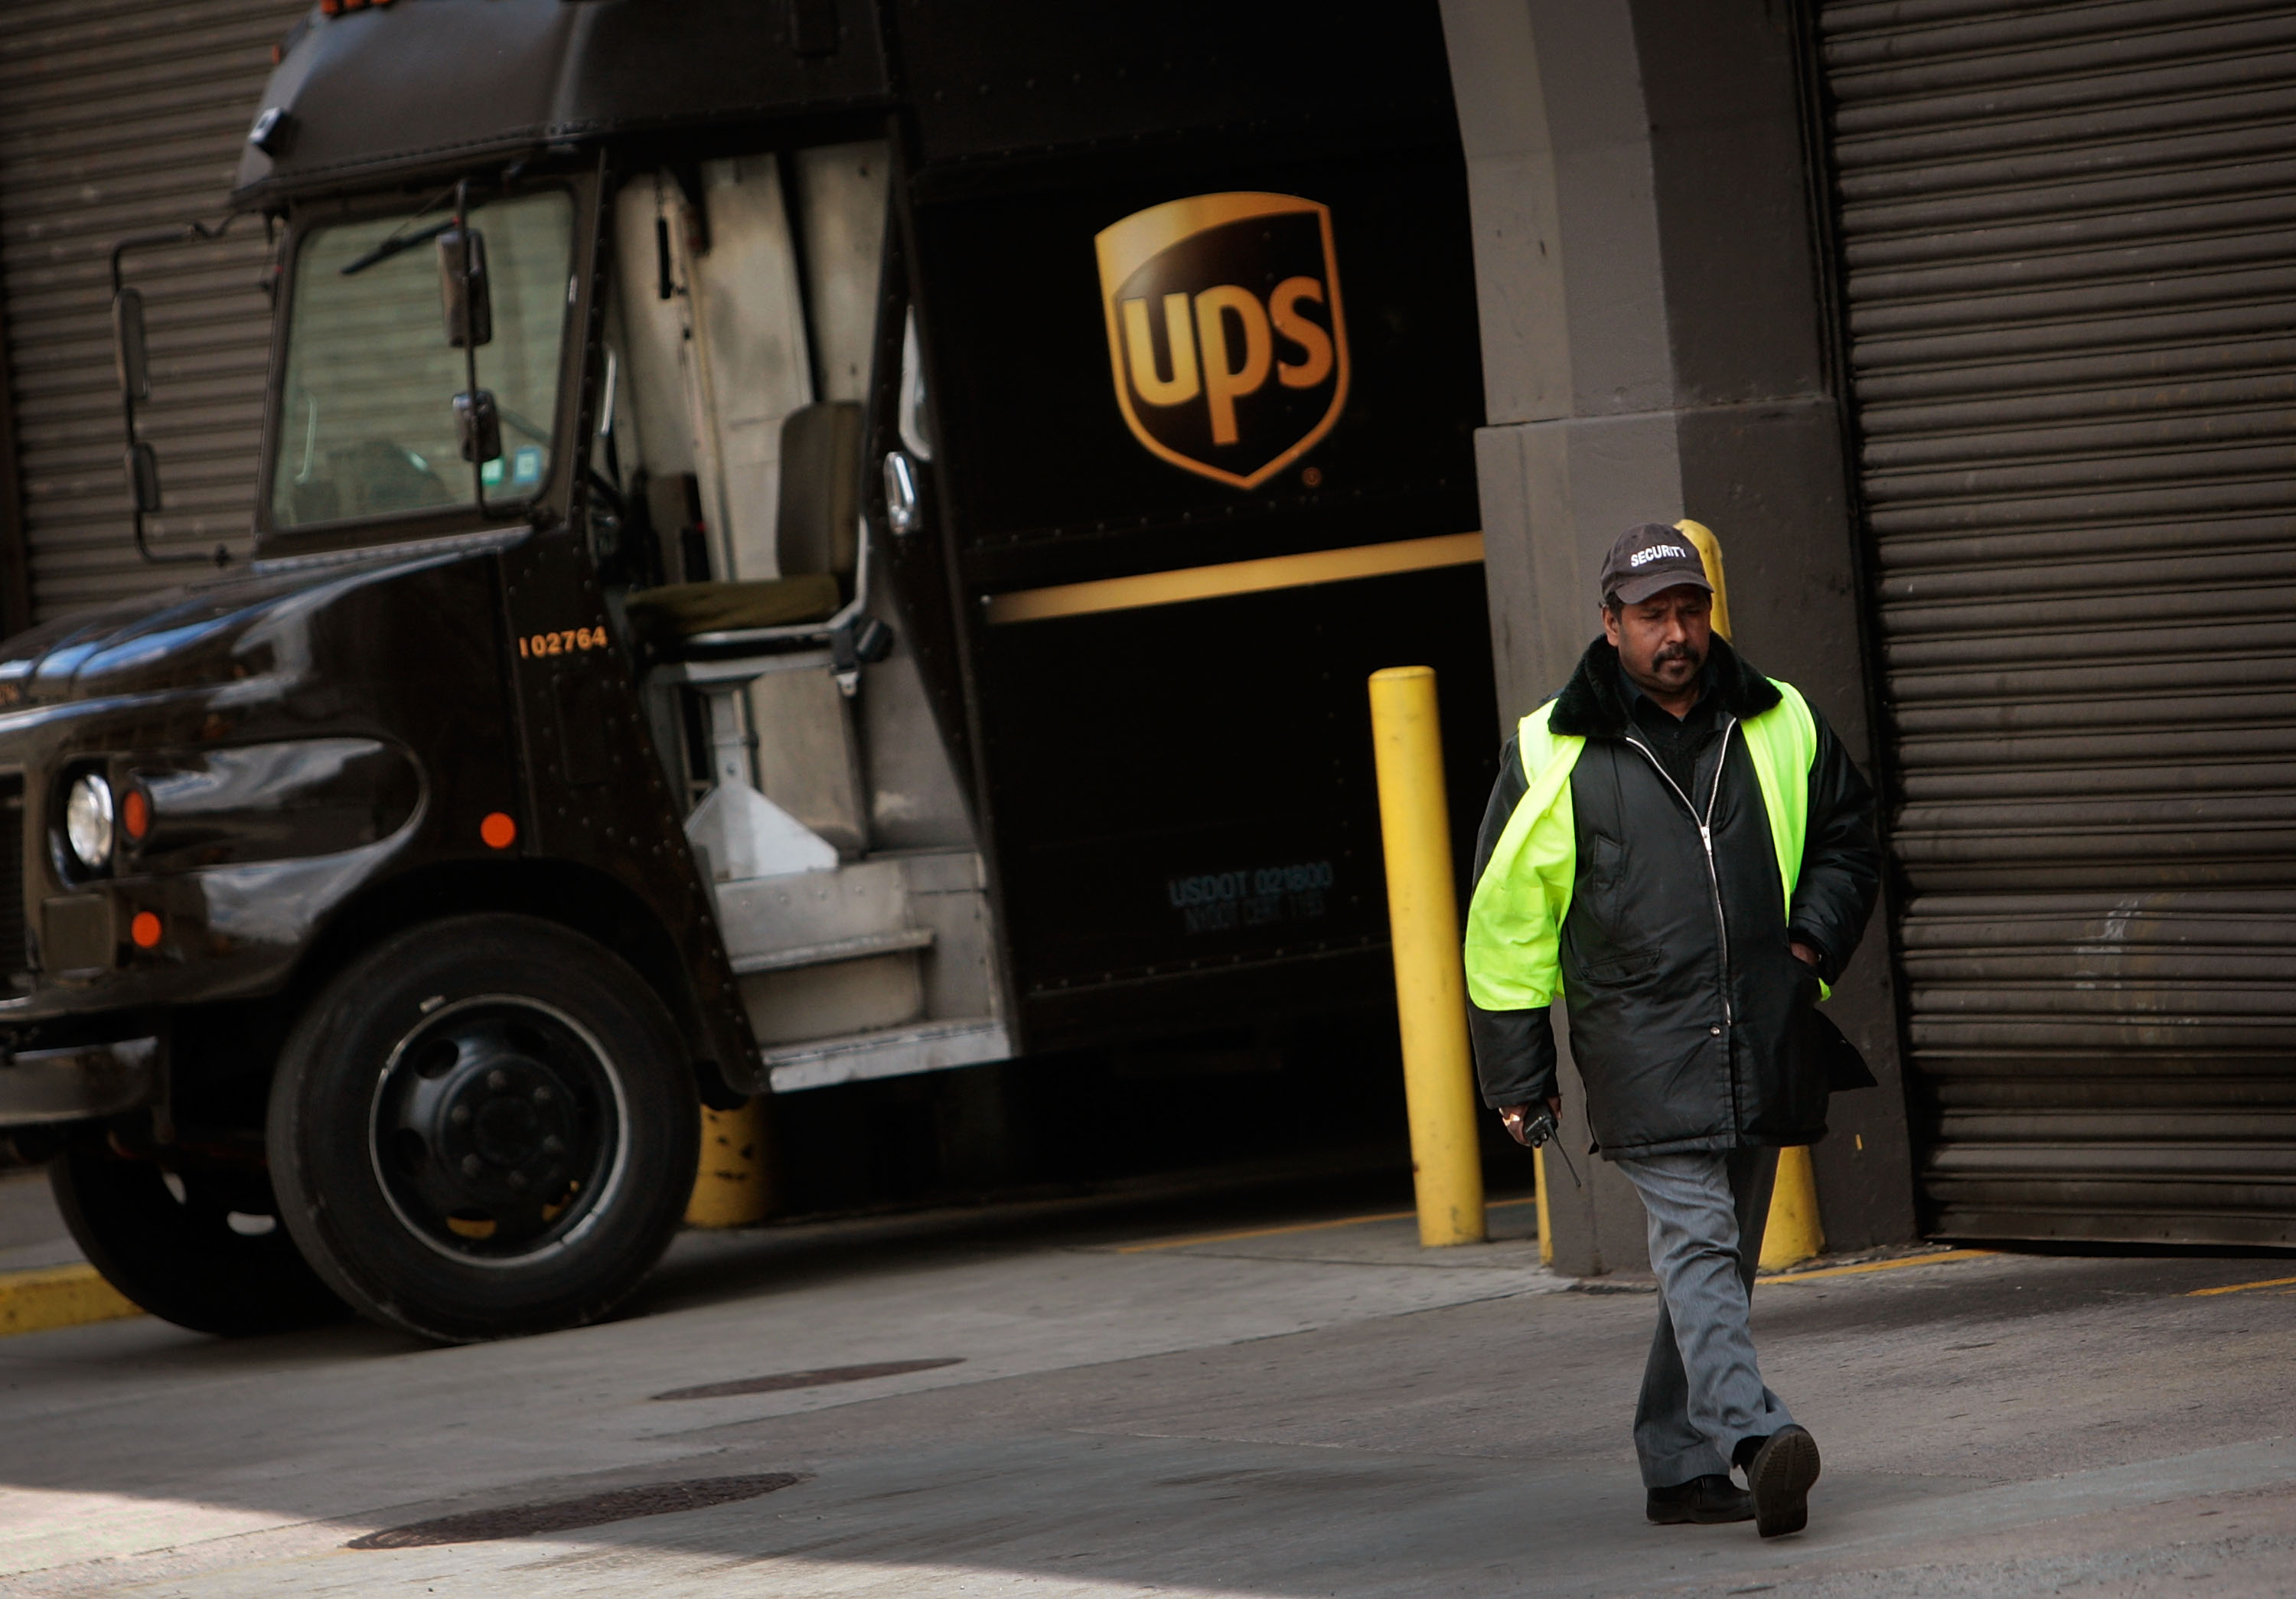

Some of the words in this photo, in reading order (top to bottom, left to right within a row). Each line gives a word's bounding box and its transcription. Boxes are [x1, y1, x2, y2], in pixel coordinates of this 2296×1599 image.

[1122, 276, 1334, 446] ups
[1631, 544, 1686, 566] SECURITY
[519, 625, 608, 658] 102764
[1168, 871, 1248, 907] USDOT
